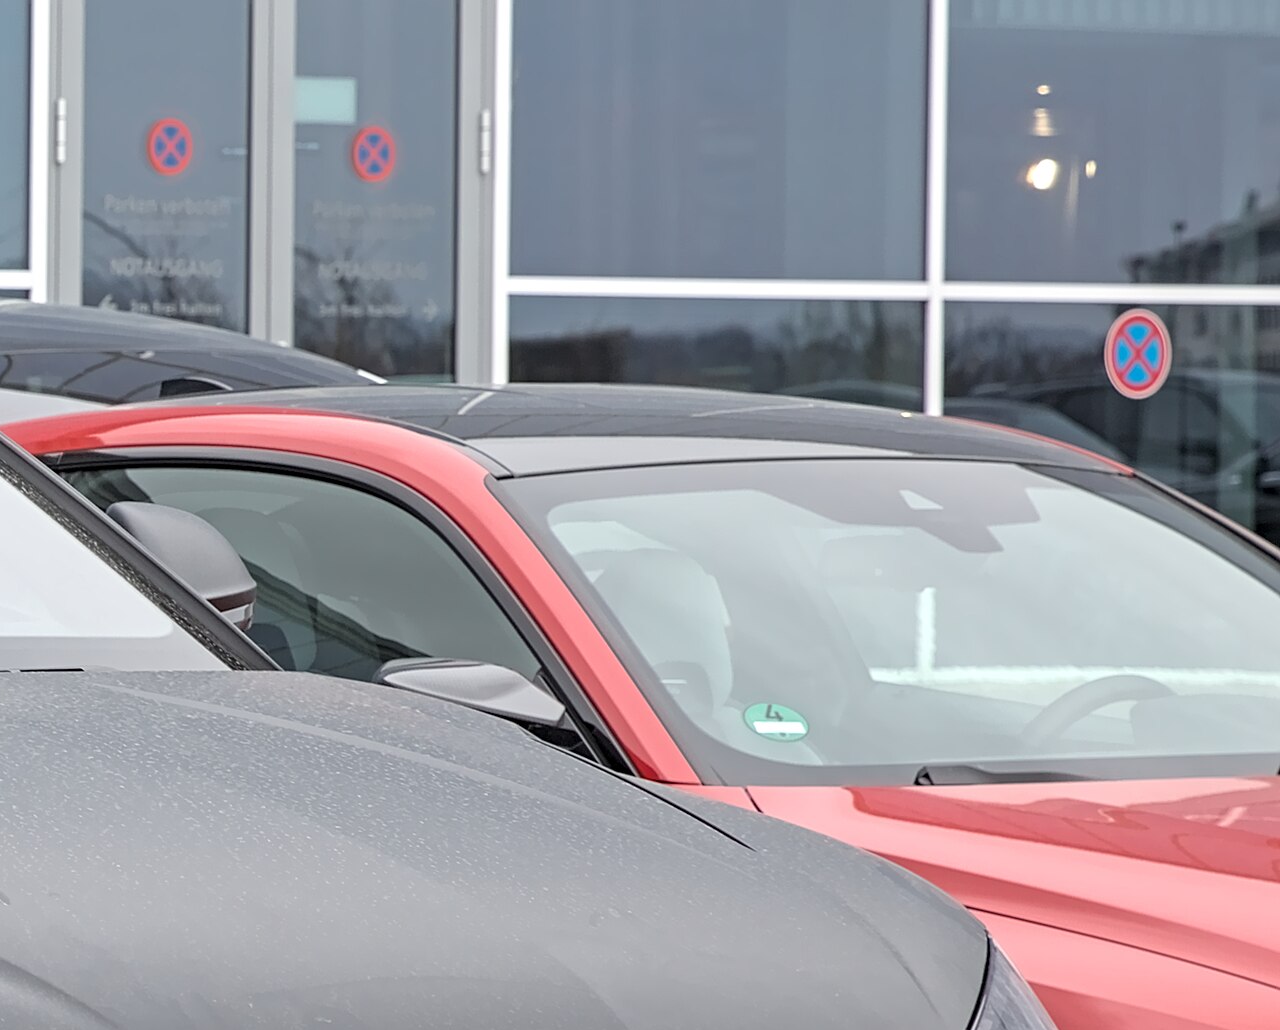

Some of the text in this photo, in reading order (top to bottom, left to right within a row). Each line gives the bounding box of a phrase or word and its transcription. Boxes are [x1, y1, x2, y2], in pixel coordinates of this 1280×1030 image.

[104, 193, 158, 214] Parken
[109, 257, 225, 279] NOTAUSGANG
[765, 703, 784, 722] 4
